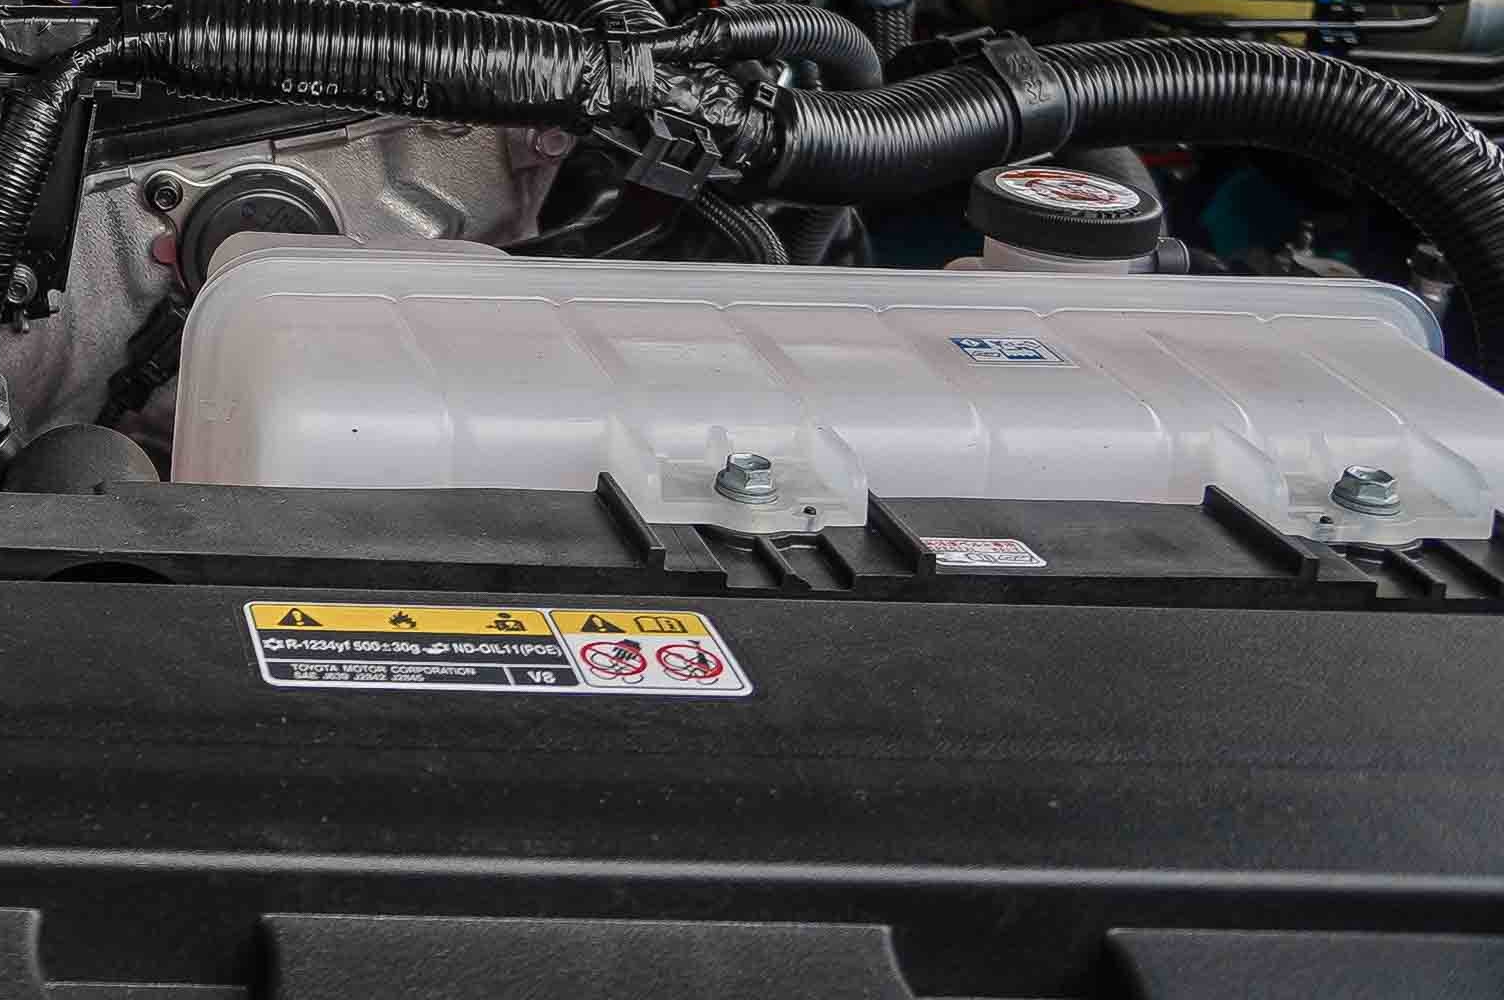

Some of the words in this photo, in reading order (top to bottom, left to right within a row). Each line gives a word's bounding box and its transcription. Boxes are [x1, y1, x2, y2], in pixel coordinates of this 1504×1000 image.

[286, 638, 351, 653] R-1234yf
[452, 642, 563, 657] ND-OIL11(POE)
[290, 663, 338, 672] TOYOTA
[343, 664, 387, 673] MOTOR
[390, 665, 477, 675] CORPORATION
